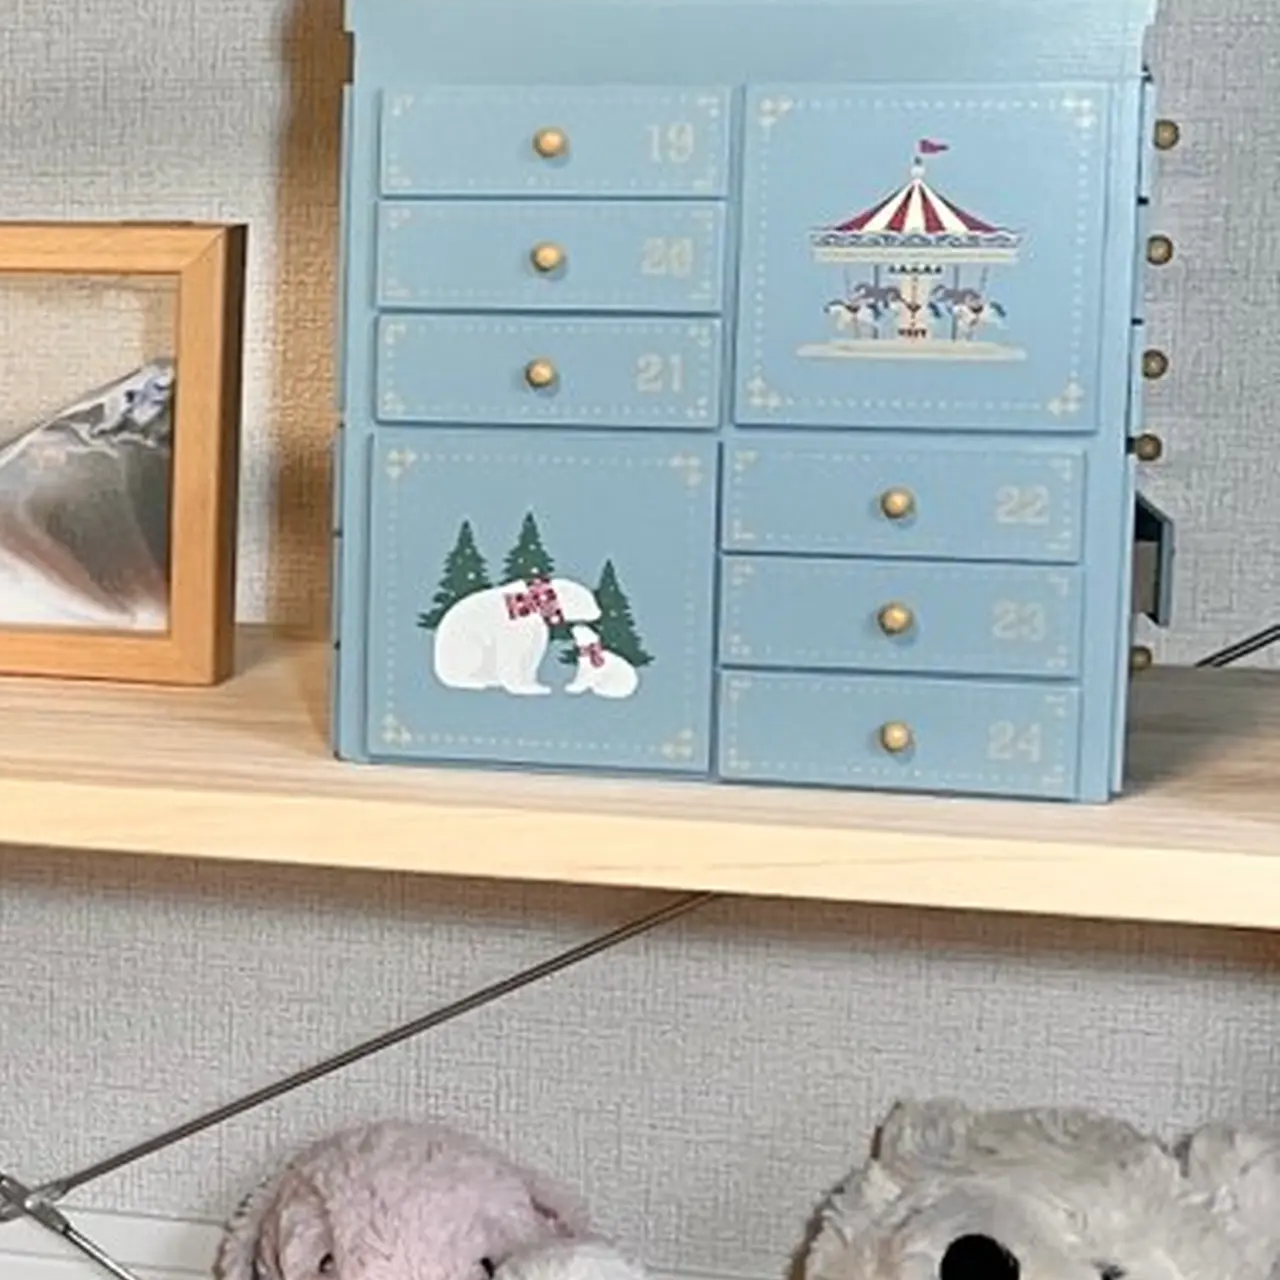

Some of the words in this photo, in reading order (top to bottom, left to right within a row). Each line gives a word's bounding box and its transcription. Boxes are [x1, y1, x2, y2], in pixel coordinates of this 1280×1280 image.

[644, 122, 694, 163] 19
[637, 353, 682, 392] 21
[996, 485, 1049, 524] 22
[992, 600, 1044, 641] 23
[988, 720, 1040, 763] 24
